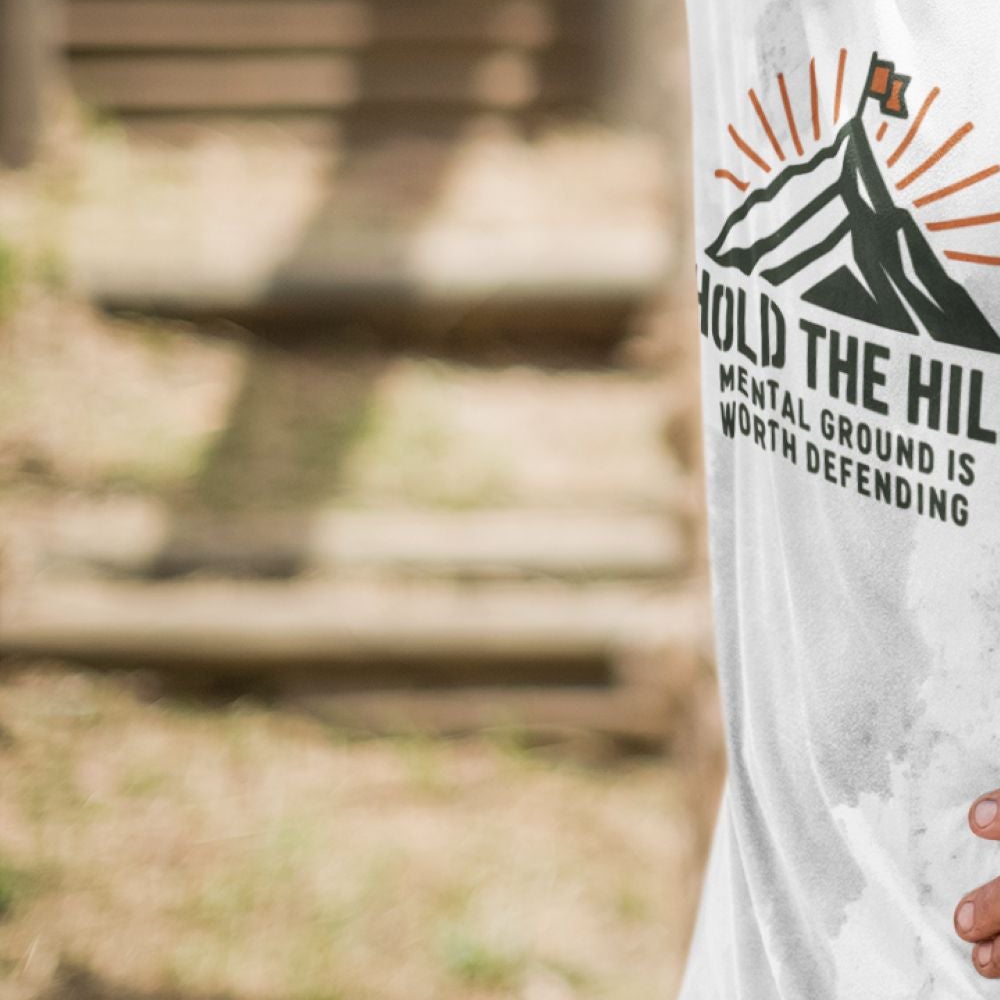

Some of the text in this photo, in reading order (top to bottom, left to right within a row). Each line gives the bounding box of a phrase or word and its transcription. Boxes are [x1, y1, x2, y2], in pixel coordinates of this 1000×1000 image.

[719, 363, 975, 487] MENTAL GROUND IS
[799, 318, 891, 416] THE
[719, 401, 969, 527] WORTH DEFENDING
